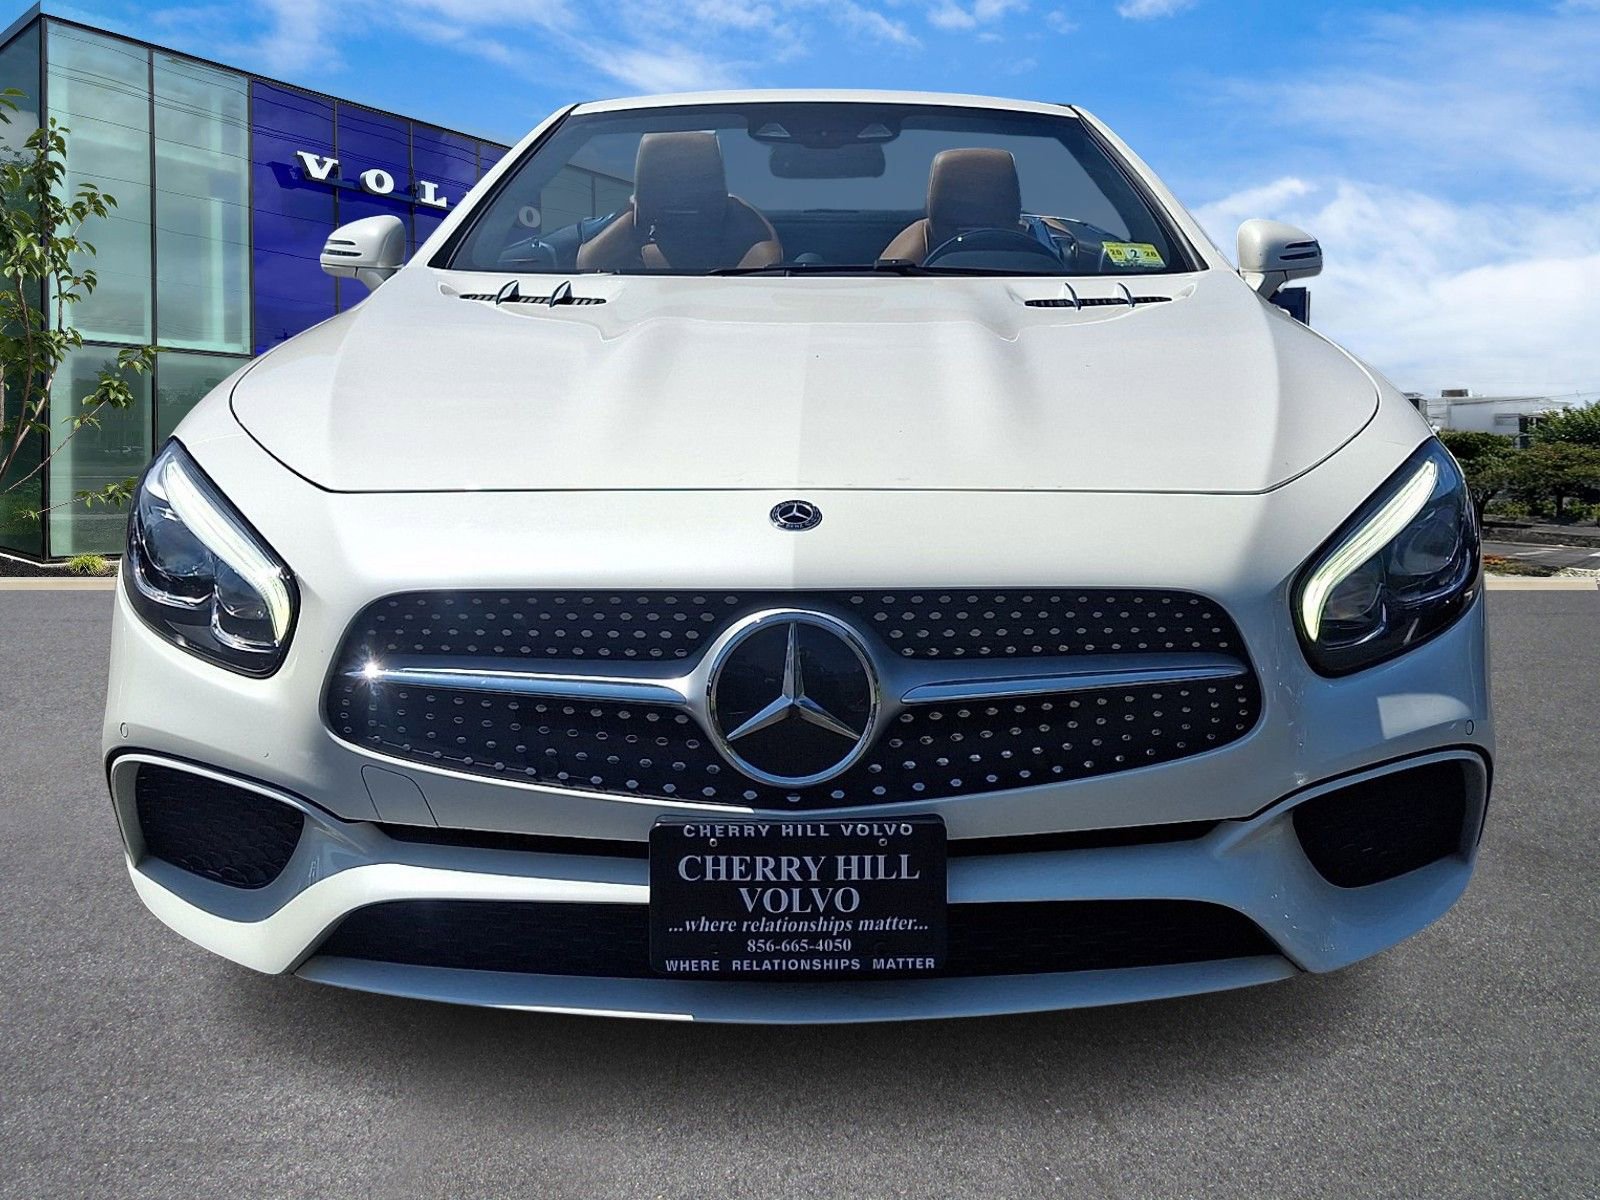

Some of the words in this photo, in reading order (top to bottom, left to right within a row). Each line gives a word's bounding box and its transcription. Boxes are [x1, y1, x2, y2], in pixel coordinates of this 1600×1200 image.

[1130, 249, 1140, 258] 2
[683, 824, 770, 837] CHERRY
[781, 824, 830, 837] HILL
[840, 823, 913, 836] VOLVO
[678, 855, 826, 882] CHERRY
[834, 854, 920, 881] HILL
[738, 886, 860, 914] VOLVO
[668, 916, 737, 932] ...where
[742, 916, 853, 935] relationships
[858, 916, 929, 931] matter...
[746, 938, 852, 953] 856-665-4050
[665, 959, 720, 972] WHERE
[732, 958, 861, 971] RELATIONSHIPS
[872, 957, 935, 970] MATTER
